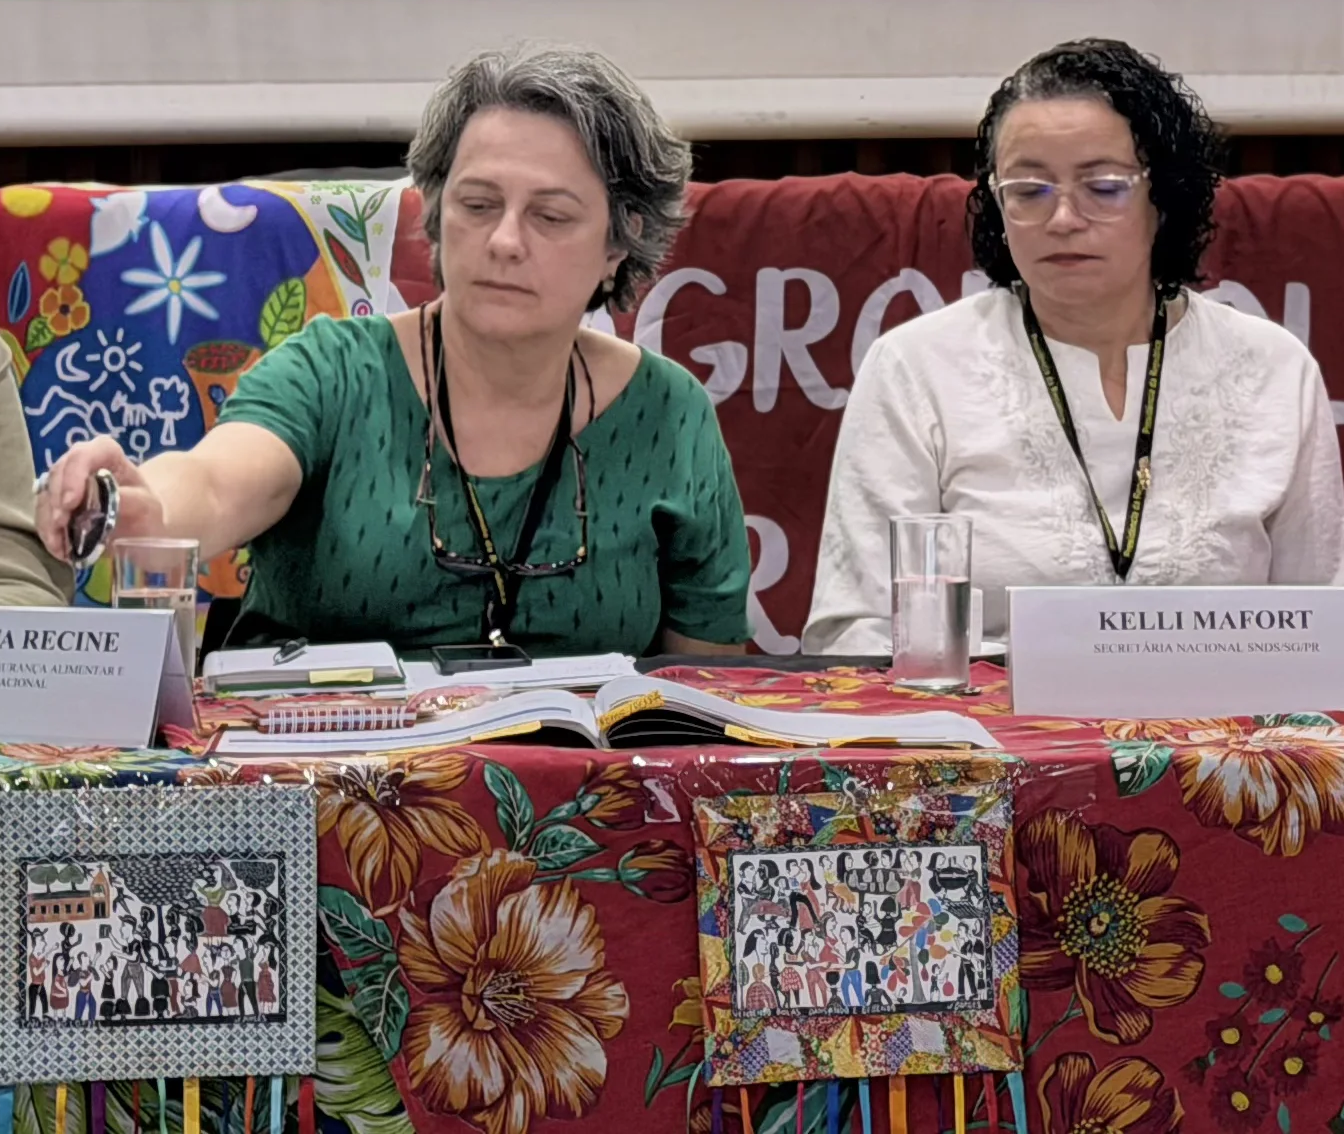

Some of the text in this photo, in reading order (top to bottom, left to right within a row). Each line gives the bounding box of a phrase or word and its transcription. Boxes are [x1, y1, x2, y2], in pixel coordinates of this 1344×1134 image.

[1099, 609, 1314, 631] KELLI MAFORT
[22, 630, 121, 654] RECINE
[1093, 640, 1173, 654] SECRETÁRIA
[1176, 641, 1243, 653] NACIONAL
[51, 664, 116, 677] ALIMENTAR
